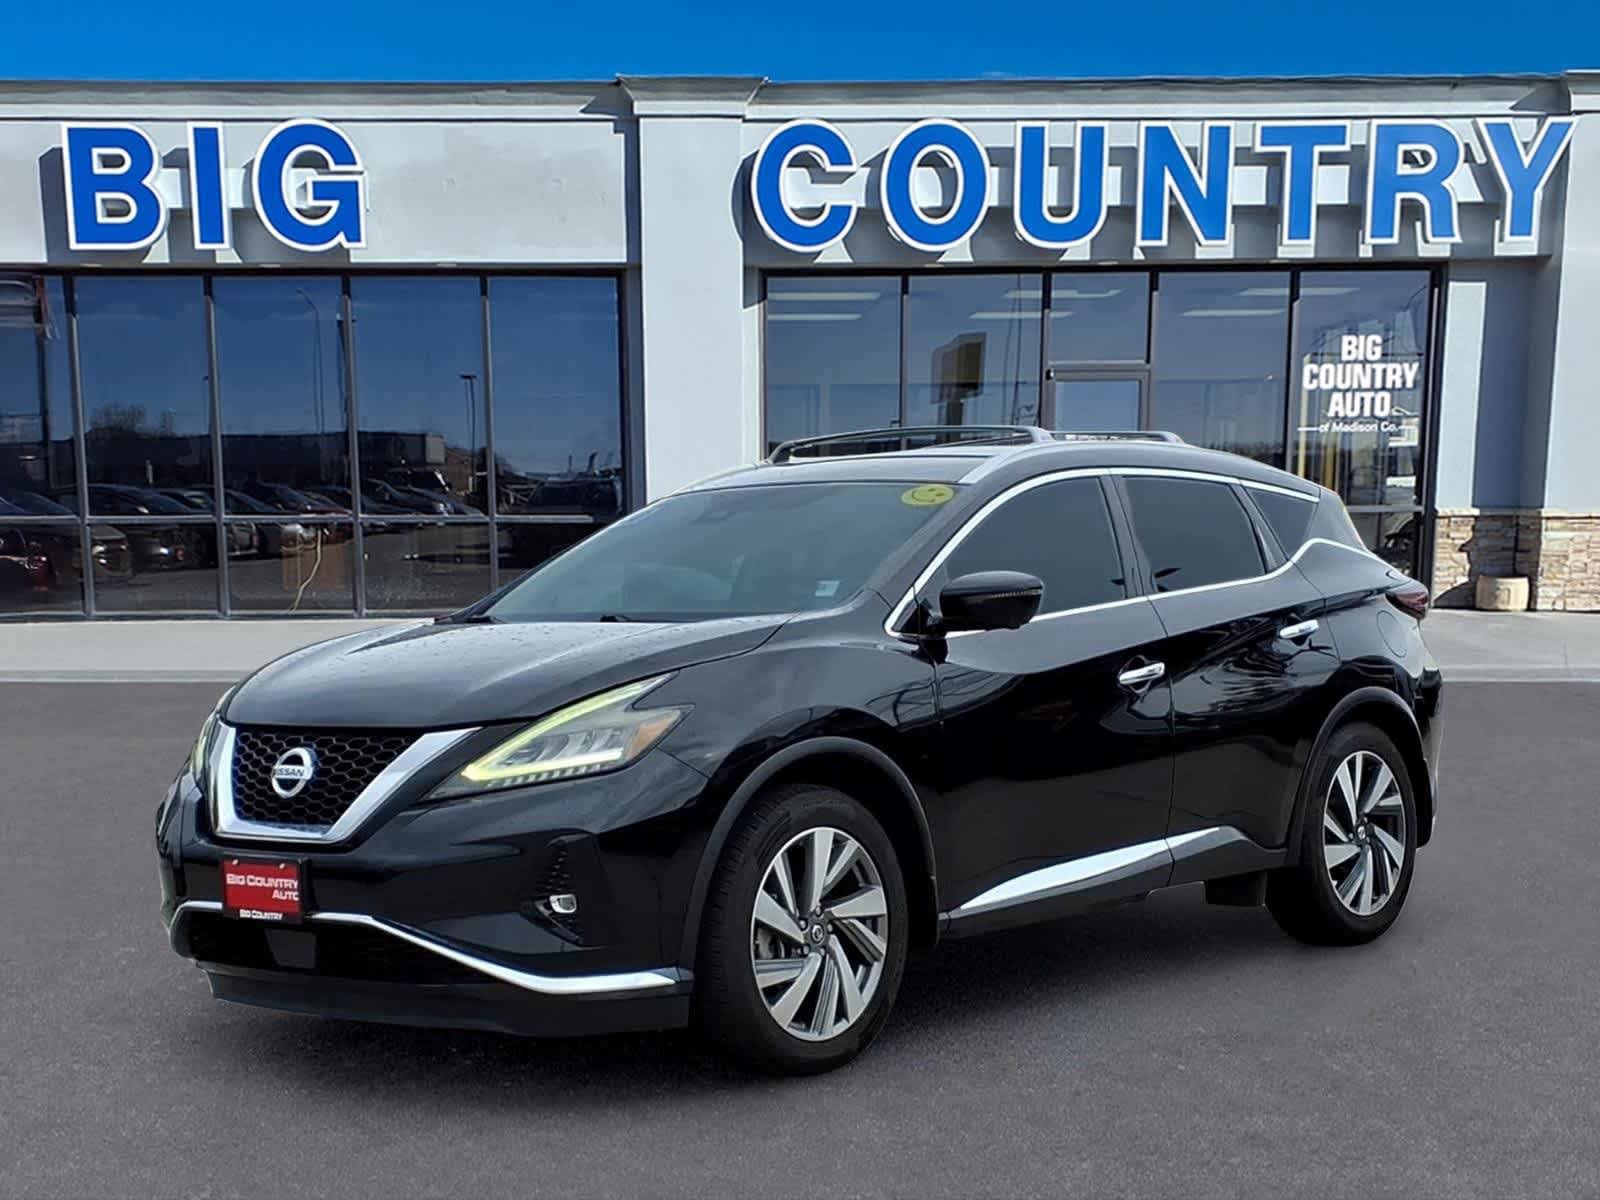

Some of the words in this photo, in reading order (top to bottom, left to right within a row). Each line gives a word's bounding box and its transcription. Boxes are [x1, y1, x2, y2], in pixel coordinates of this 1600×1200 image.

[61, 119, 367, 252] BIG
[749, 115, 1577, 254] COUNTRY
[1341, 335, 1383, 361] BIG
[1302, 362, 1419, 390] COUNTRY
[1328, 392, 1391, 417] AUTO
[274, 768, 304, 777] NISSAN
[226, 874, 246, 886] BIG
[246, 875, 298, 889] COUNTRY
